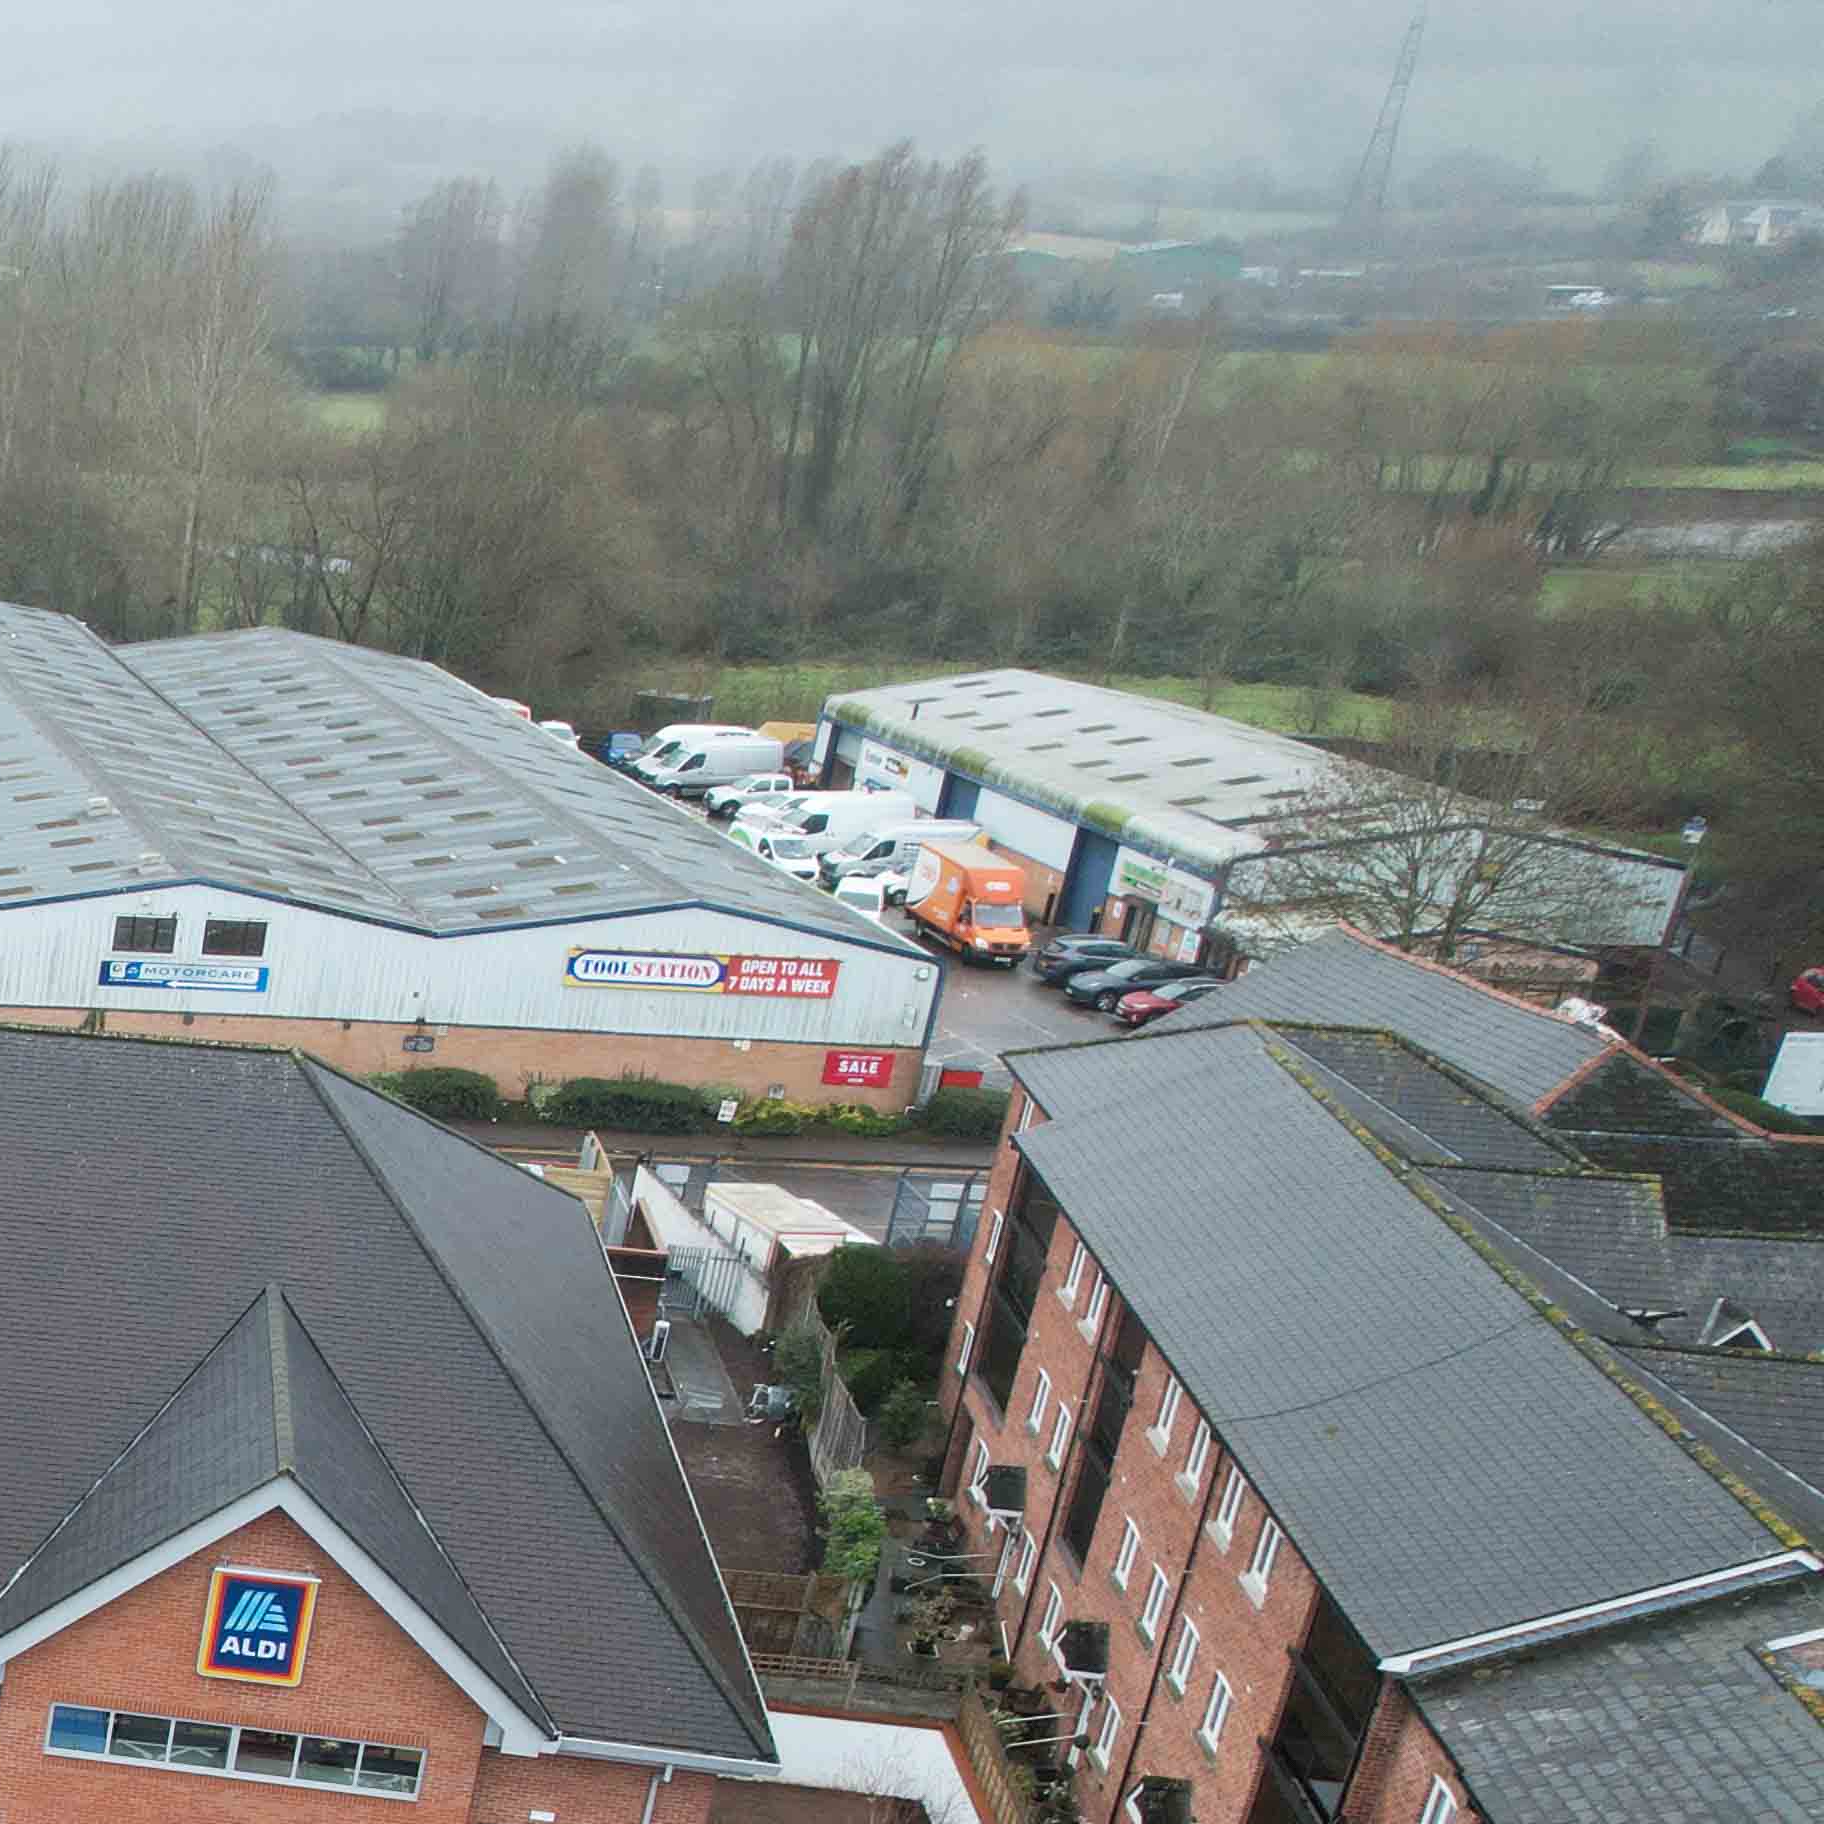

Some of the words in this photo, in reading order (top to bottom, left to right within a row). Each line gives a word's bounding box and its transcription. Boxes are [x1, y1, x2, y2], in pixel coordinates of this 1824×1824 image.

[143, 967, 255, 980] MOTORCARE
[582, 958, 715, 981] TOOLSTATION
[741, 959, 778, 976] OPEN
[781, 960, 798, 976] TO
[801, 961, 825, 977] ALL
[727, 975, 736, 990] 7
[739, 976, 775, 991] DAYS
[776, 977, 788, 992] A
[791, 977, 832, 994] WEEK
[838, 1060, 881, 1075] SALE
[219, 1635, 287, 1661] ALDI
